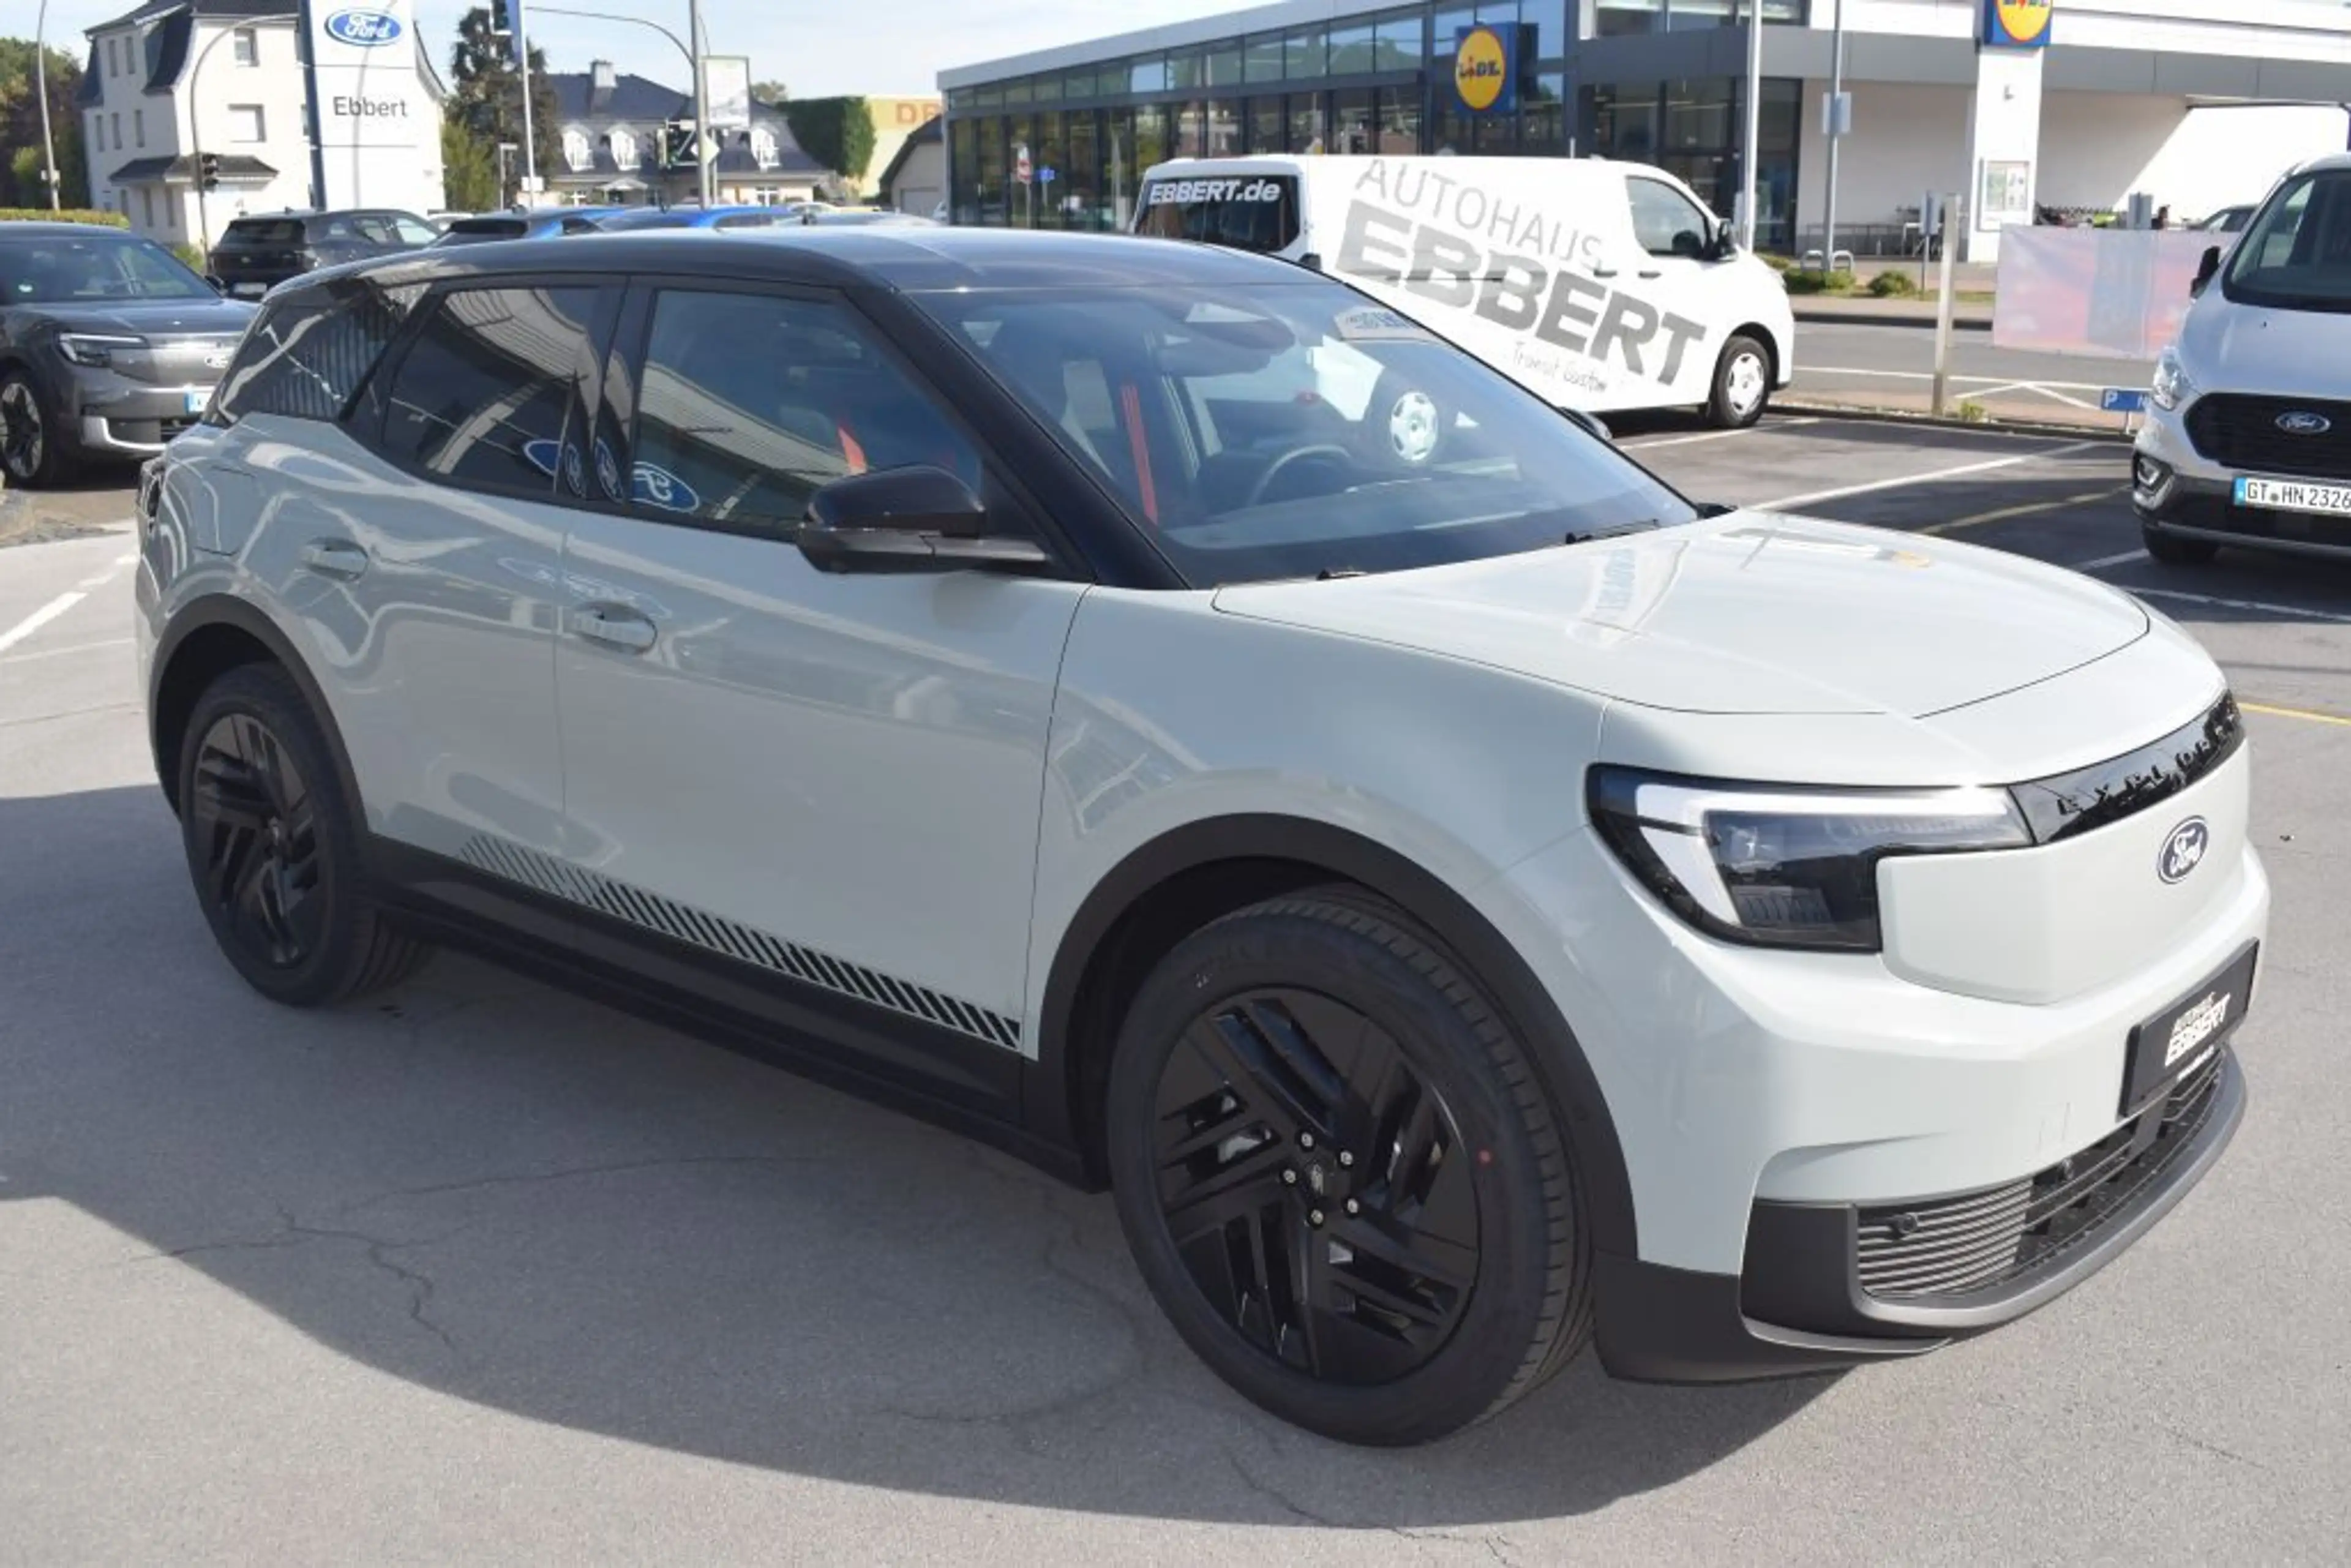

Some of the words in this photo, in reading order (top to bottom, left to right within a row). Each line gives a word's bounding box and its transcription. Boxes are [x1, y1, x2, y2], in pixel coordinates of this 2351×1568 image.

[344, 13, 391, 37] Ford
[332, 96, 408, 118] Ebbert
[1149, 178, 1281, 206] EBBERT.de
[1355, 158, 1605, 271] AUTOHAUS
[1335, 198, 1708, 386] EBBERT
[2248, 482, 2268, 502] GT
[2282, 484, 2304, 505] HN
[2308, 488, 2351, 511] 2326
[2169, 827, 2203, 876] Ford
